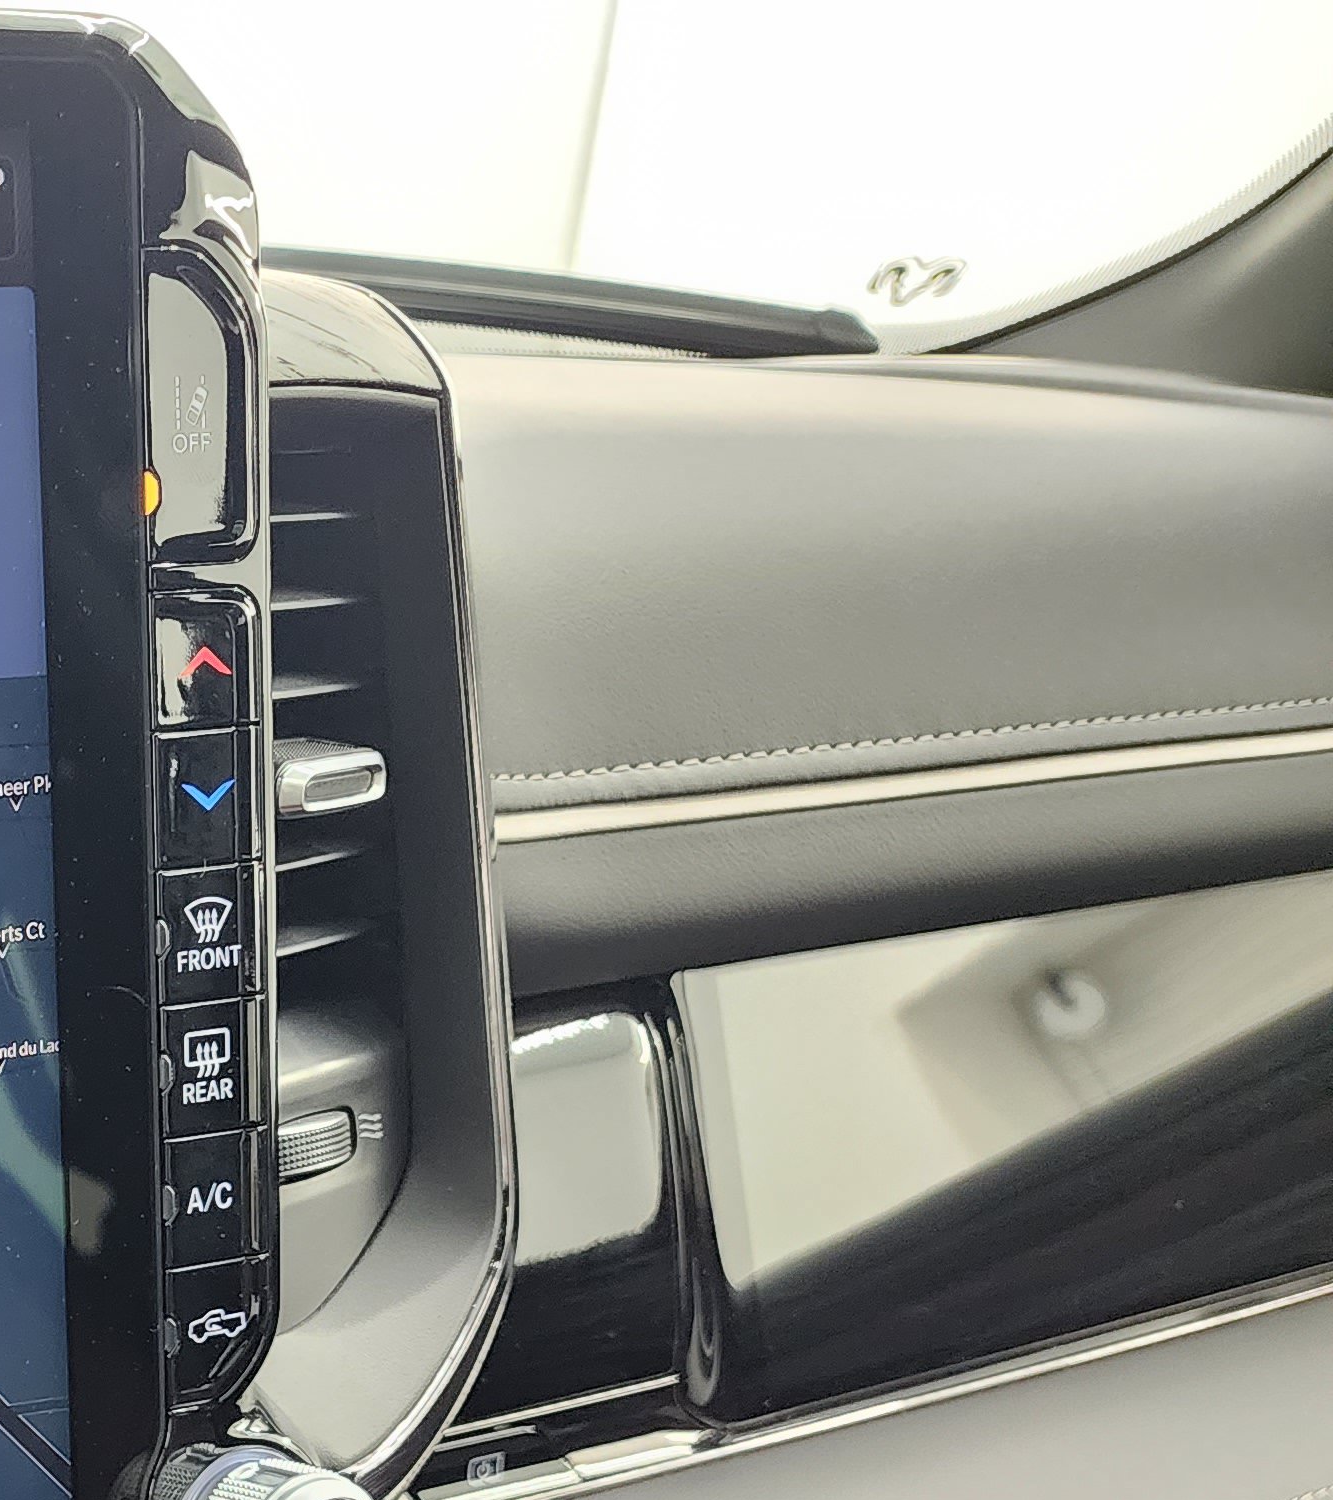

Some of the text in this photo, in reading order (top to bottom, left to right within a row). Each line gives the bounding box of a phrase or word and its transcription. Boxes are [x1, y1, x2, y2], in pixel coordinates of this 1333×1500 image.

[172, 432, 212, 454] OFF
[25, 921, 46, 940] Ct
[176, 945, 242, 974] FRONT
[19, 1040, 37, 1057] du
[182, 1077, 234, 1105] REAR
[186, 1182, 233, 1216] A/C
